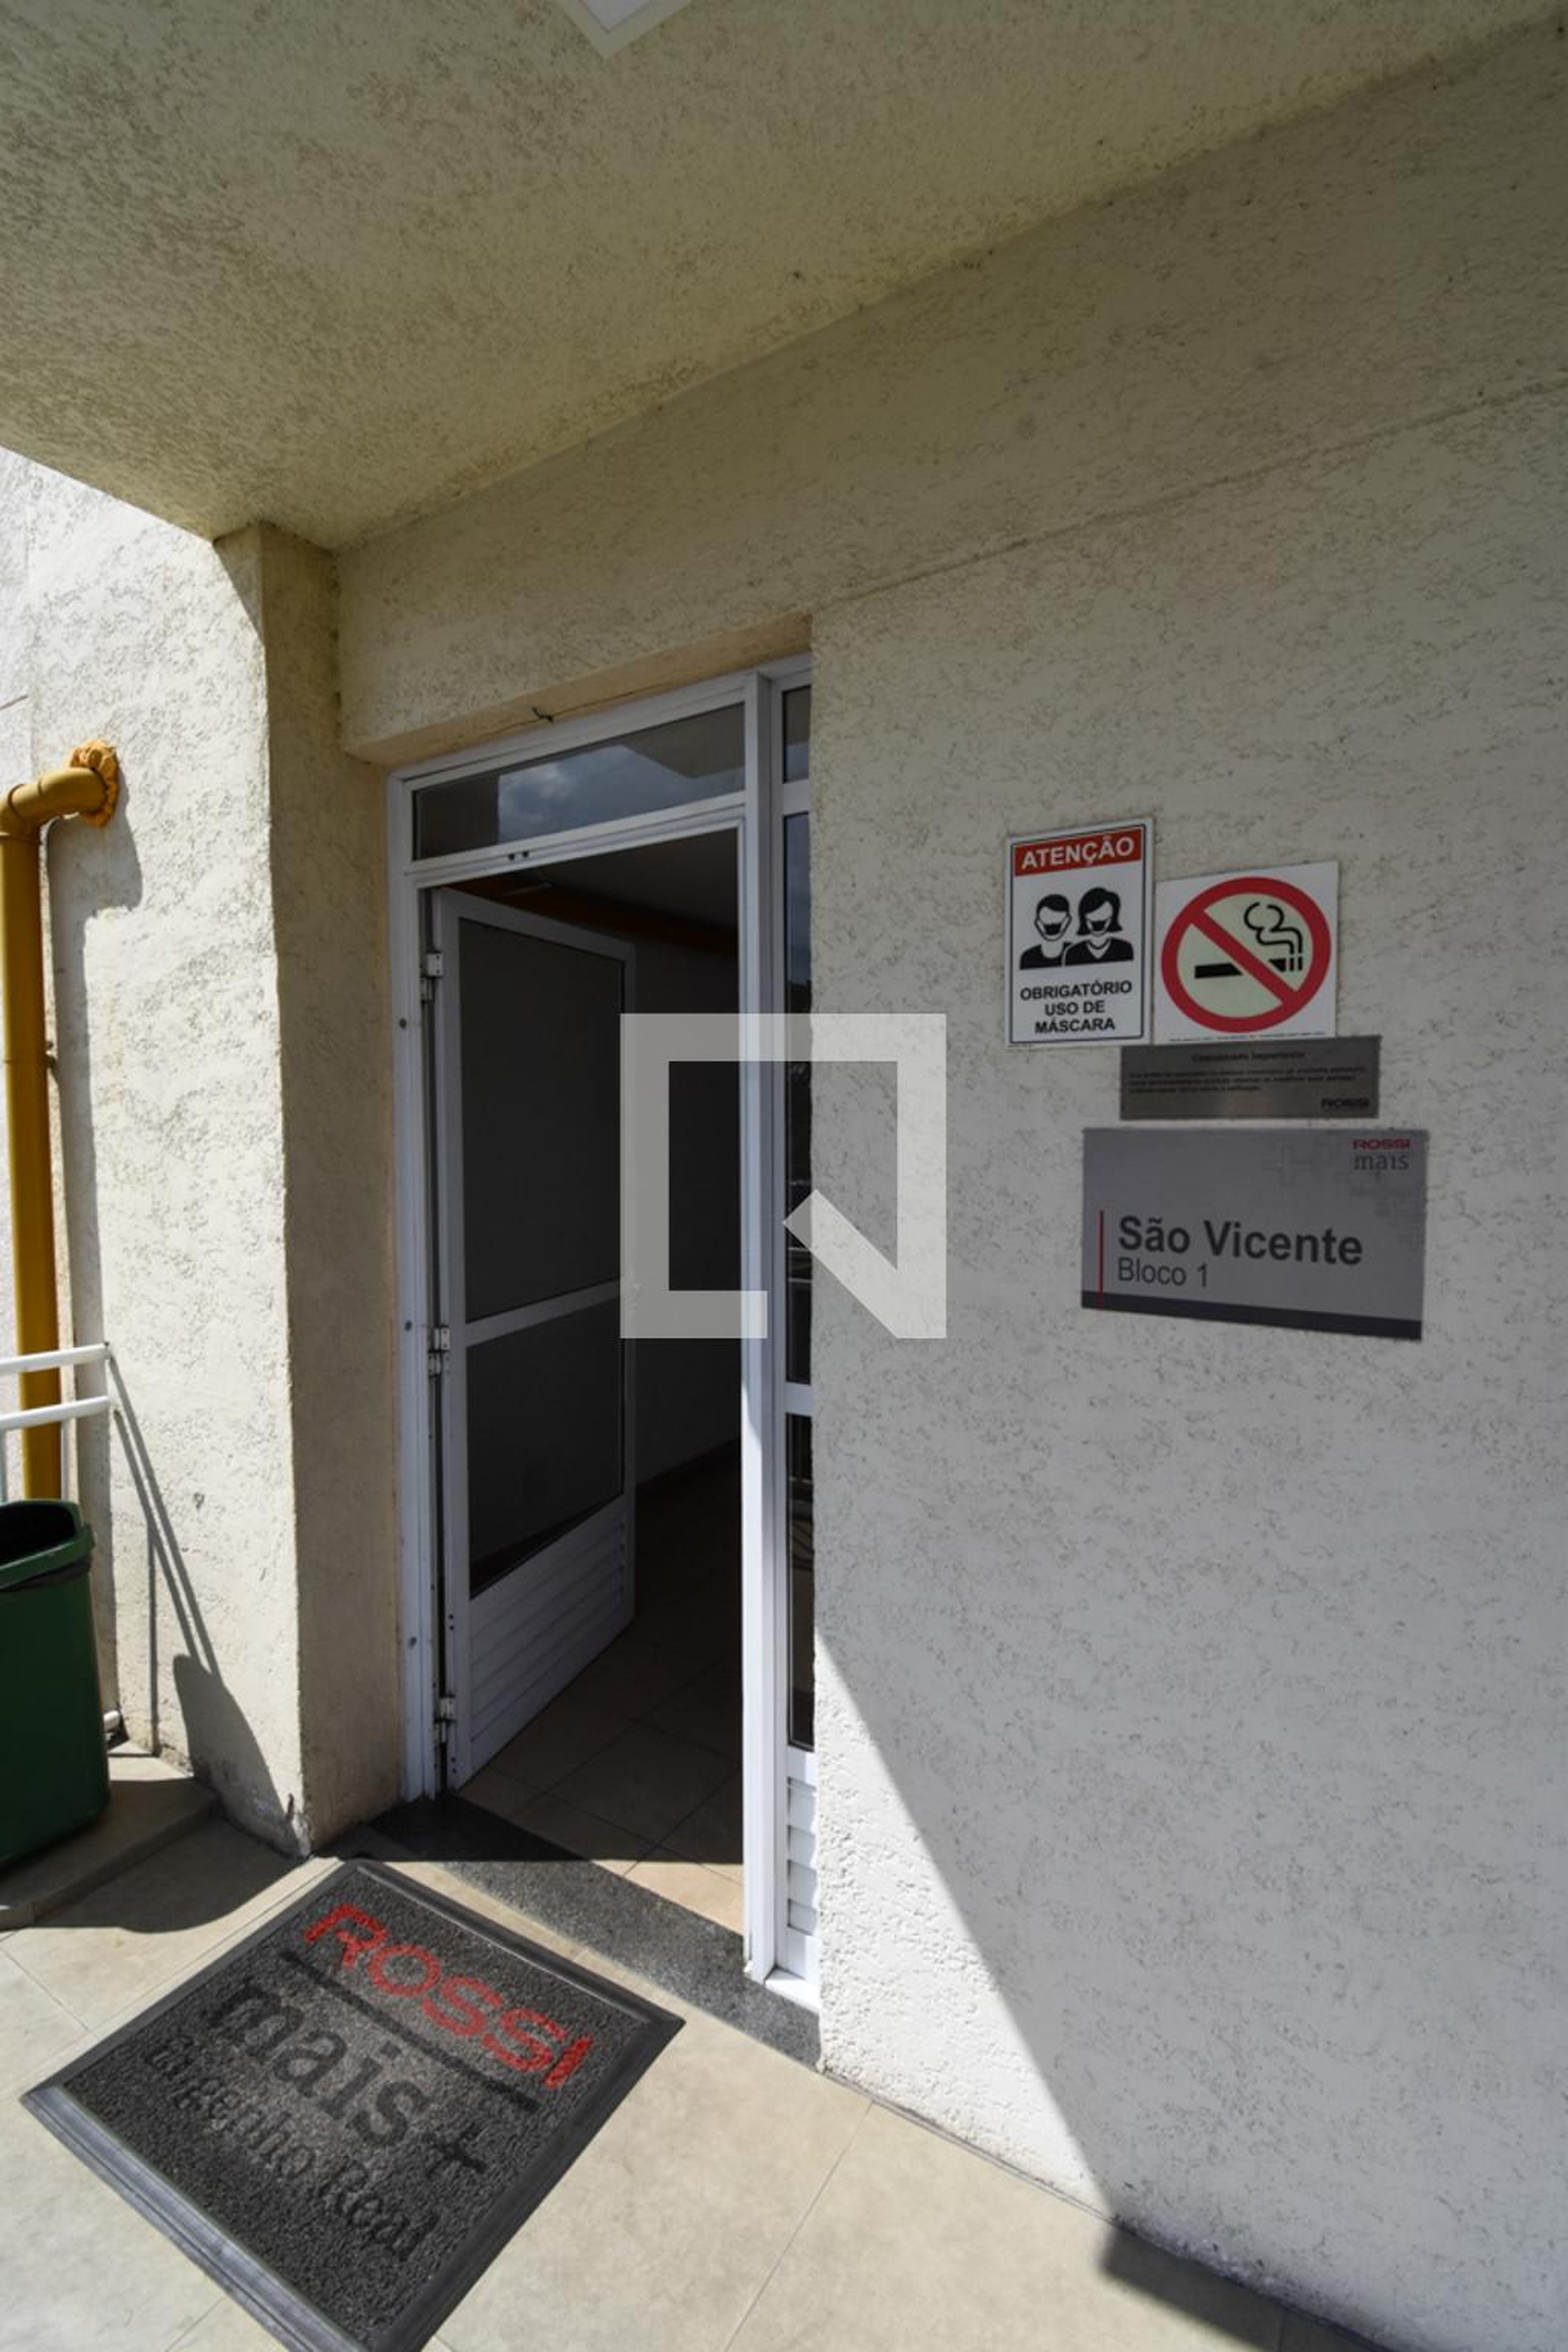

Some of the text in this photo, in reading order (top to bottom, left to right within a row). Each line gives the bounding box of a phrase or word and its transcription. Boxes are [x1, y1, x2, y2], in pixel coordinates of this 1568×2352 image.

[1022, 835, 1134, 869] ATENÇÃO
[1021, 980, 1132, 1000] OBRIGATÓRIO
[1045, 1000, 1105, 1016] USO DE
[1035, 1017, 1115, 1033] MÁSCARA
[1354, 1154, 1409, 1170] mais
[1119, 1215, 1363, 1265] São Vicente
[1118, 1257, 1207, 1287] Bloco 1
[305, 1903, 593, 2089] ROSSI
